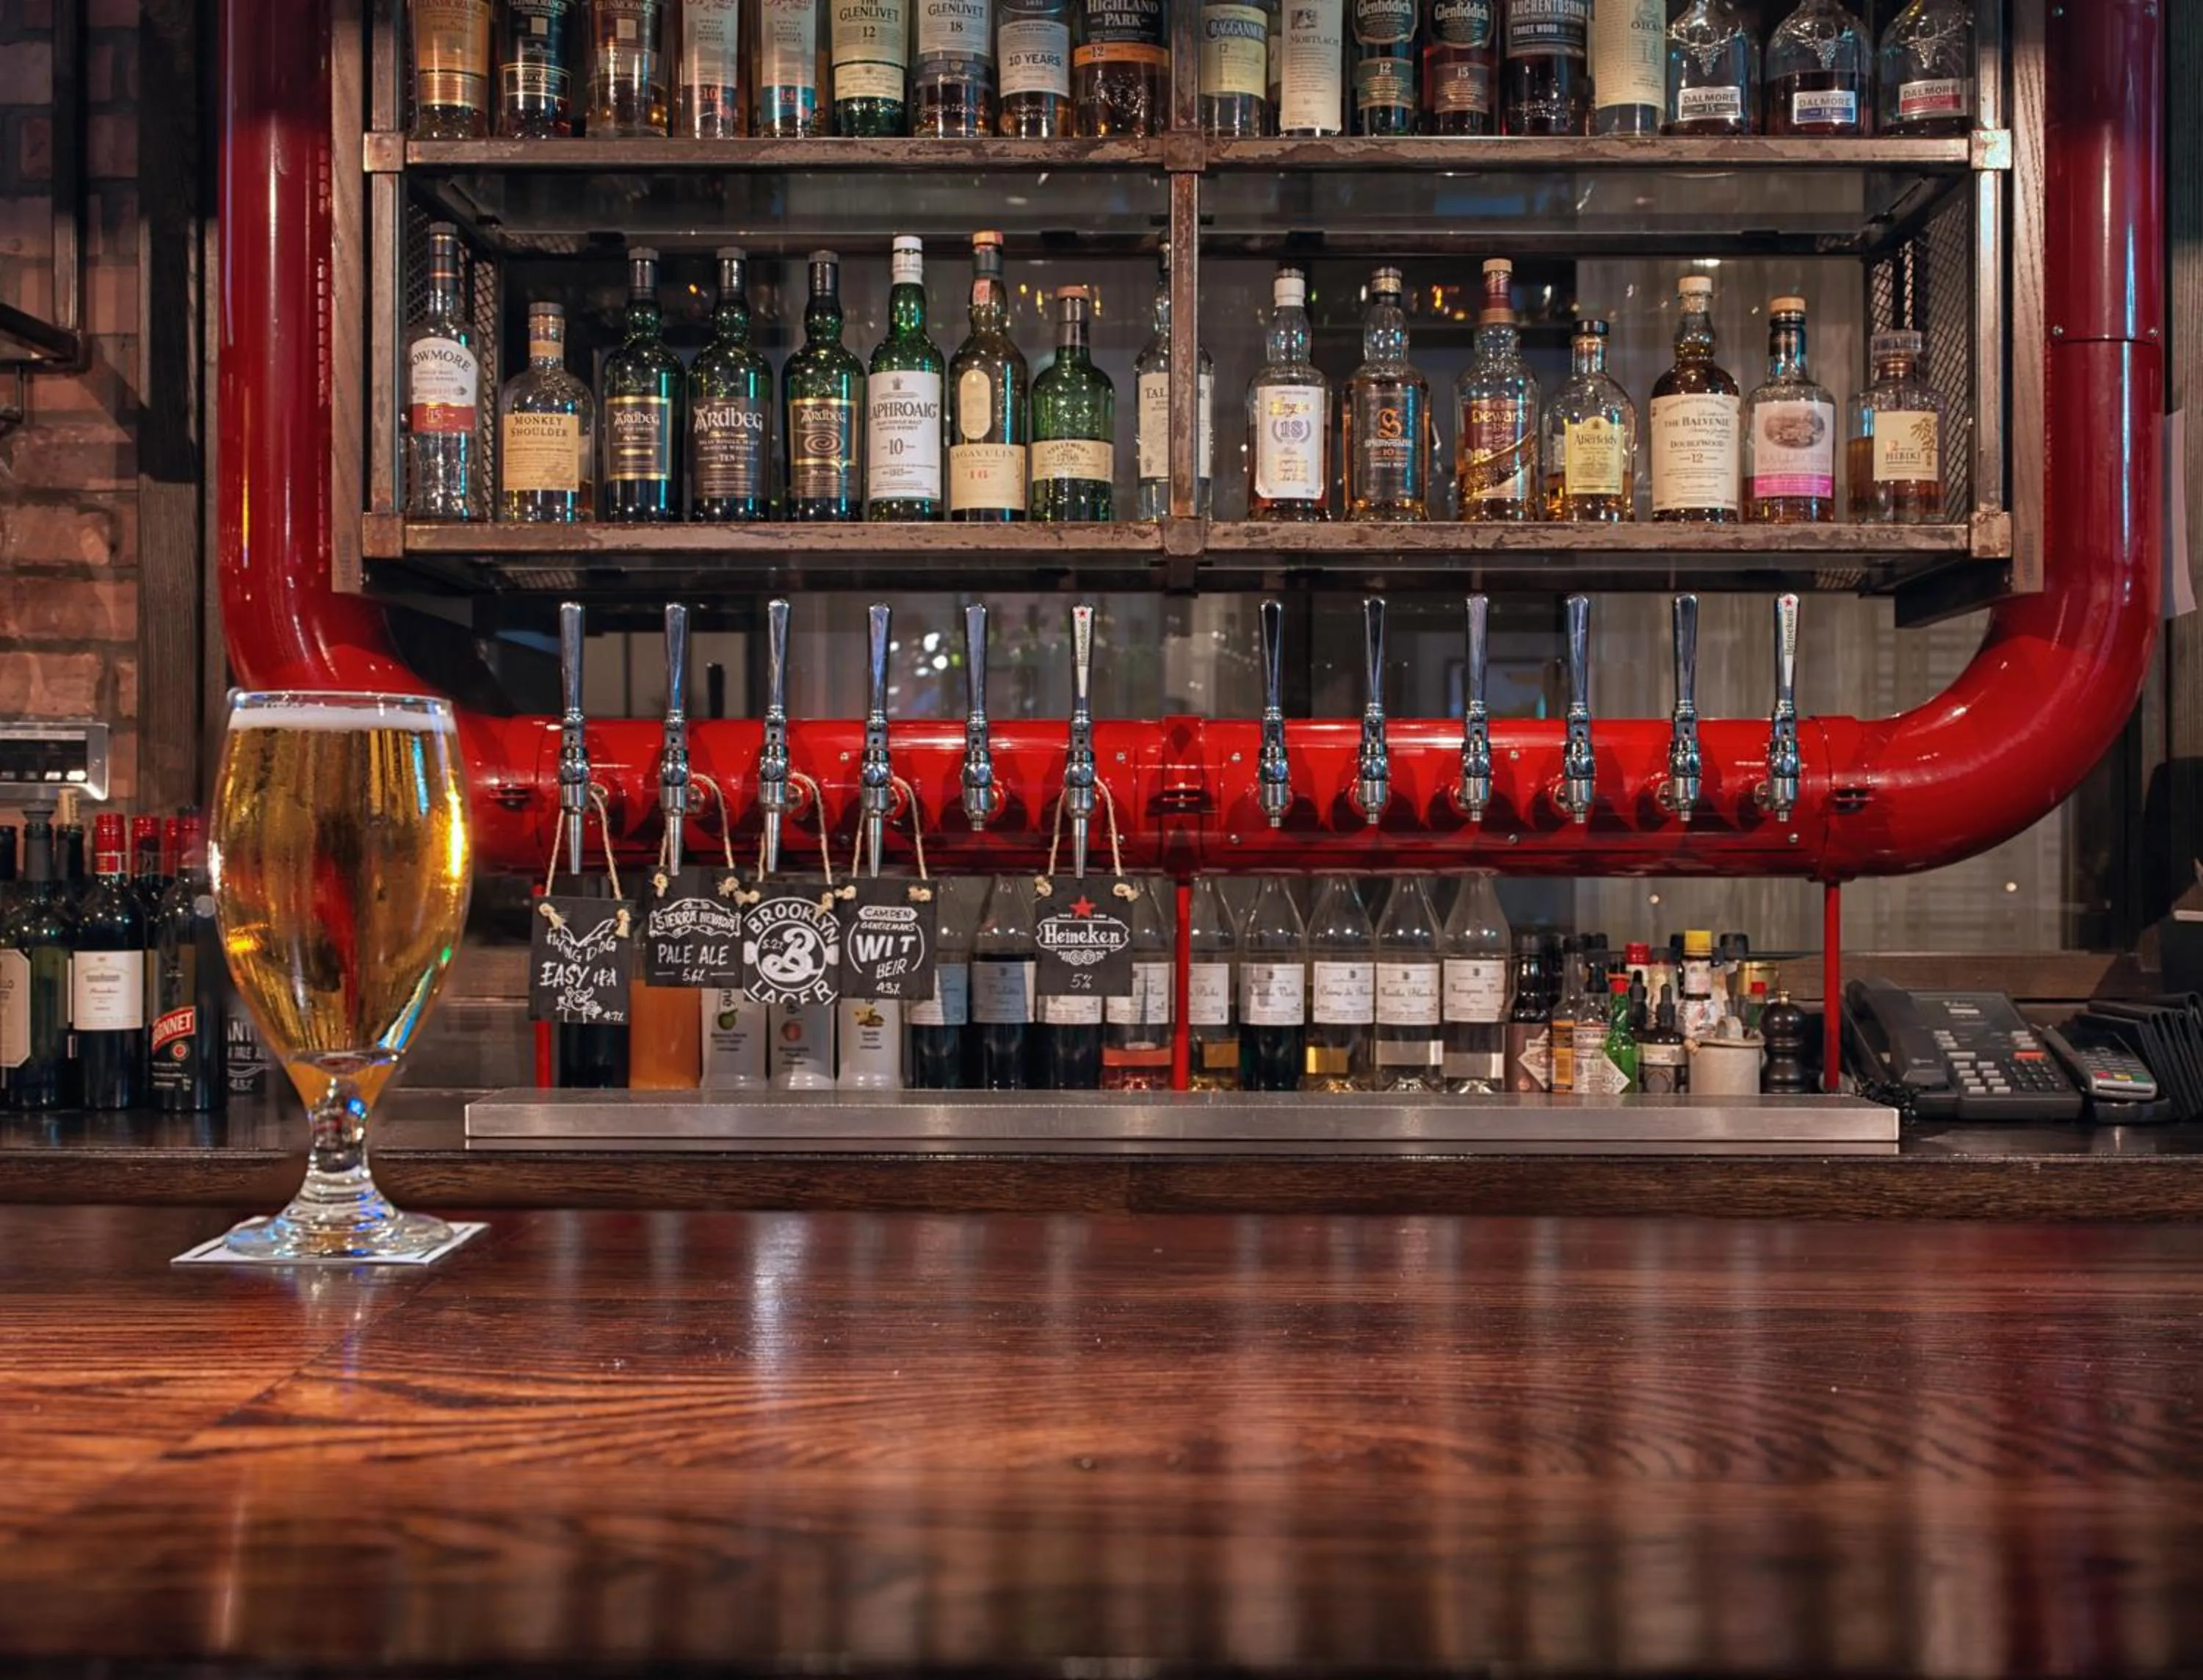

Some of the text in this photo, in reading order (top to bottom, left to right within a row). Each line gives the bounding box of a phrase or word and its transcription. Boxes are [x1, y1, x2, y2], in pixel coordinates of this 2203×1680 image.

[840, 7, 899, 21] GLENLIVET
[928, 4, 984, 18] GLENLIVET
[1434, 2, 1489, 21] Glenfiddich
[950, 21, 963, 32] 18
[1104, 13, 1141, 26] PARK
[863, 26, 876, 37] 12
[1008, 53, 1062, 67] 10 YEARS
[1378, 62, 1392, 74] 12
[1457, 67, 1469, 78] 15
[703, 89, 717, 101] 10
[780, 89, 795, 101] 14
[1684, 94, 1737, 104] DALMORE
[1798, 97, 1853, 107] DALMORE
[411, 349, 471, 372] OWMORE
[515, 416, 563, 426] MONKEY
[510, 427, 568, 437] SHOULDER
[1281, 420, 1303, 438] 18
[889, 438, 904, 455] 10
[1691, 453, 1704, 463] 12
[1786, 609, 1794, 656] Heineken
[864, 908, 911, 918] CAMDEN
[655, 911, 697, 930] SIERRA
[1043, 923, 1121, 944] Heineken
[587, 935, 618, 962] DOG
[657, 943, 730, 966] PALE ALE
[855, 935, 917, 962] WIT
[539, 961, 618, 988] EASY IPA
[875, 957, 908, 979] BEIR
[1070, 973, 1093, 989] 5%
